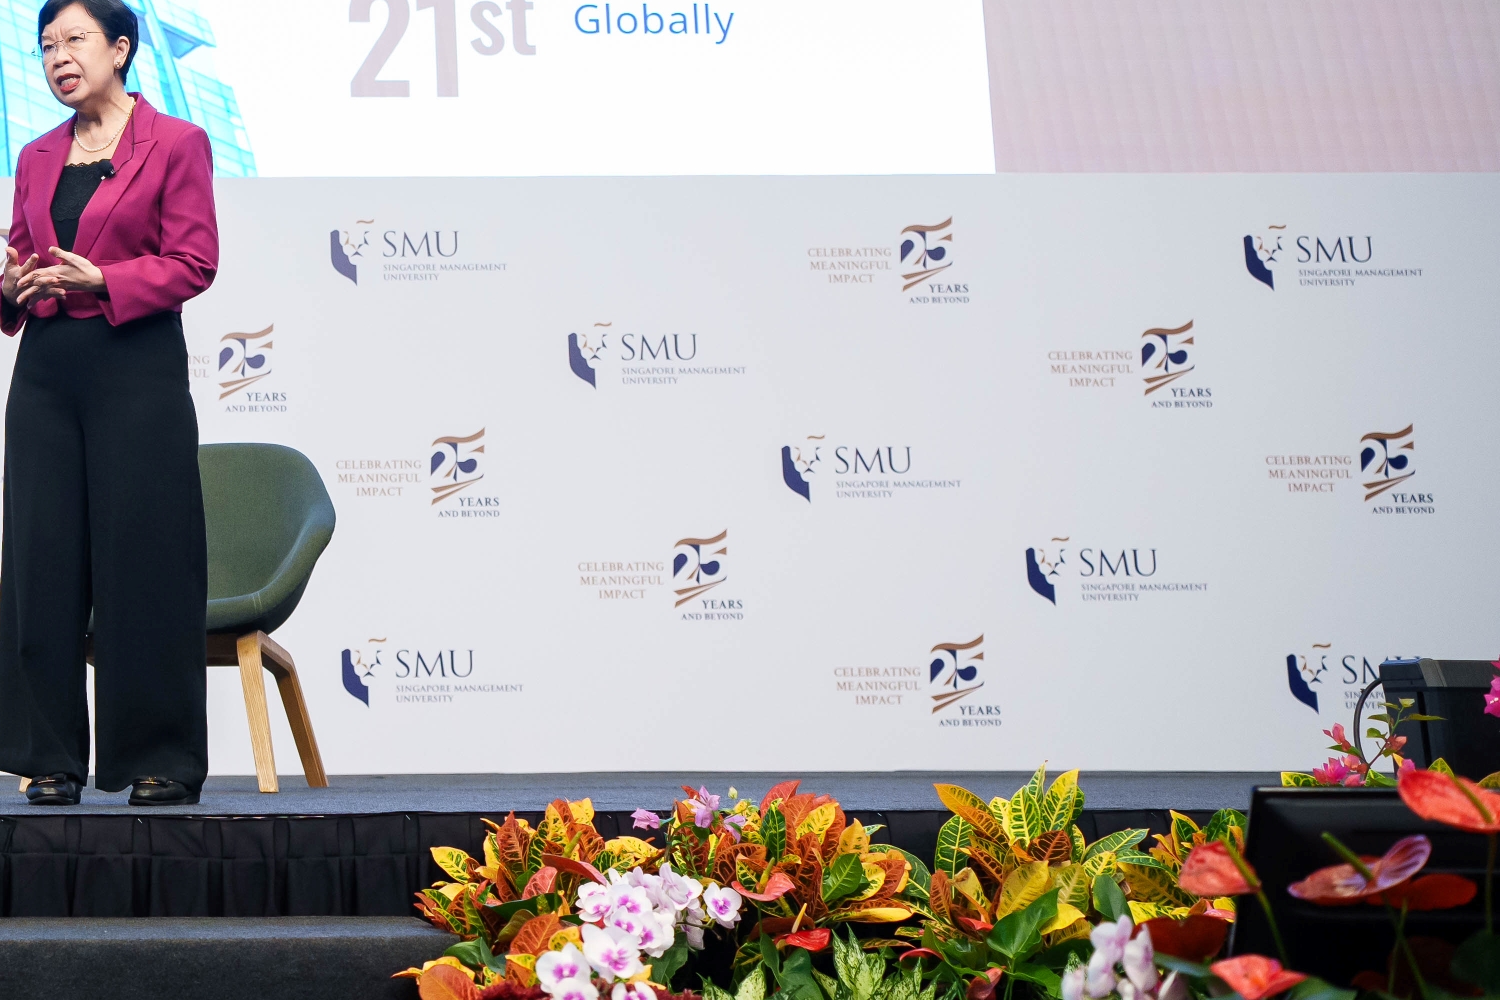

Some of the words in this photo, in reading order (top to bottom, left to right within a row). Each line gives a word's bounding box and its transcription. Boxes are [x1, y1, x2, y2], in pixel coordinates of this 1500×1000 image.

[574, 4, 734, 44] Globally
[382, 231, 459, 257] SMU
[1296, 236, 1373, 263] SMU
[1299, 278, 1356, 286] UNIVERSITY
[1047, 351, 1133, 360] CELEBRATING
[1050, 365, 1135, 373] MEANINGFUL
[1069, 377, 1116, 386] IMPACT
[1170, 388, 1212, 397] YEARS
[335, 460, 422, 469] CELEBRATING
[834, 447, 911, 473] SMU
[1265, 456, 1353, 465] CELEBRATING
[337, 474, 422, 482] MEANINGFUL
[1268, 469, 1354, 478] MEANINGFUL
[356, 487, 403, 496] IMPACT
[1287, 483, 1335, 492] IMPACT
[458, 497, 500, 506] YEARS
[1391, 493, 1434, 503] YEARS
[1372, 506, 1394, 514] AND
[577, 562, 665, 571] CELEBRATING
[1079, 549, 1157, 576] SMU
[579, 576, 664, 585] MEANINGFUL
[1080, 583, 1137, 591] SINGAPORE
[1139, 583, 1208, 591] MANAGEMENT
[598, 590, 645, 599] IMPACT
[1081, 593, 1140, 601] UNIVERSITY
[701, 600, 744, 609] YEARS
[395, 650, 473, 677] SMU
[833, 667, 921, 677] CELEBRATING
[836, 681, 921, 690] MEANINGFUL
[855, 695, 903, 704] IMPACT
[959, 706, 1002, 715] YEARS
